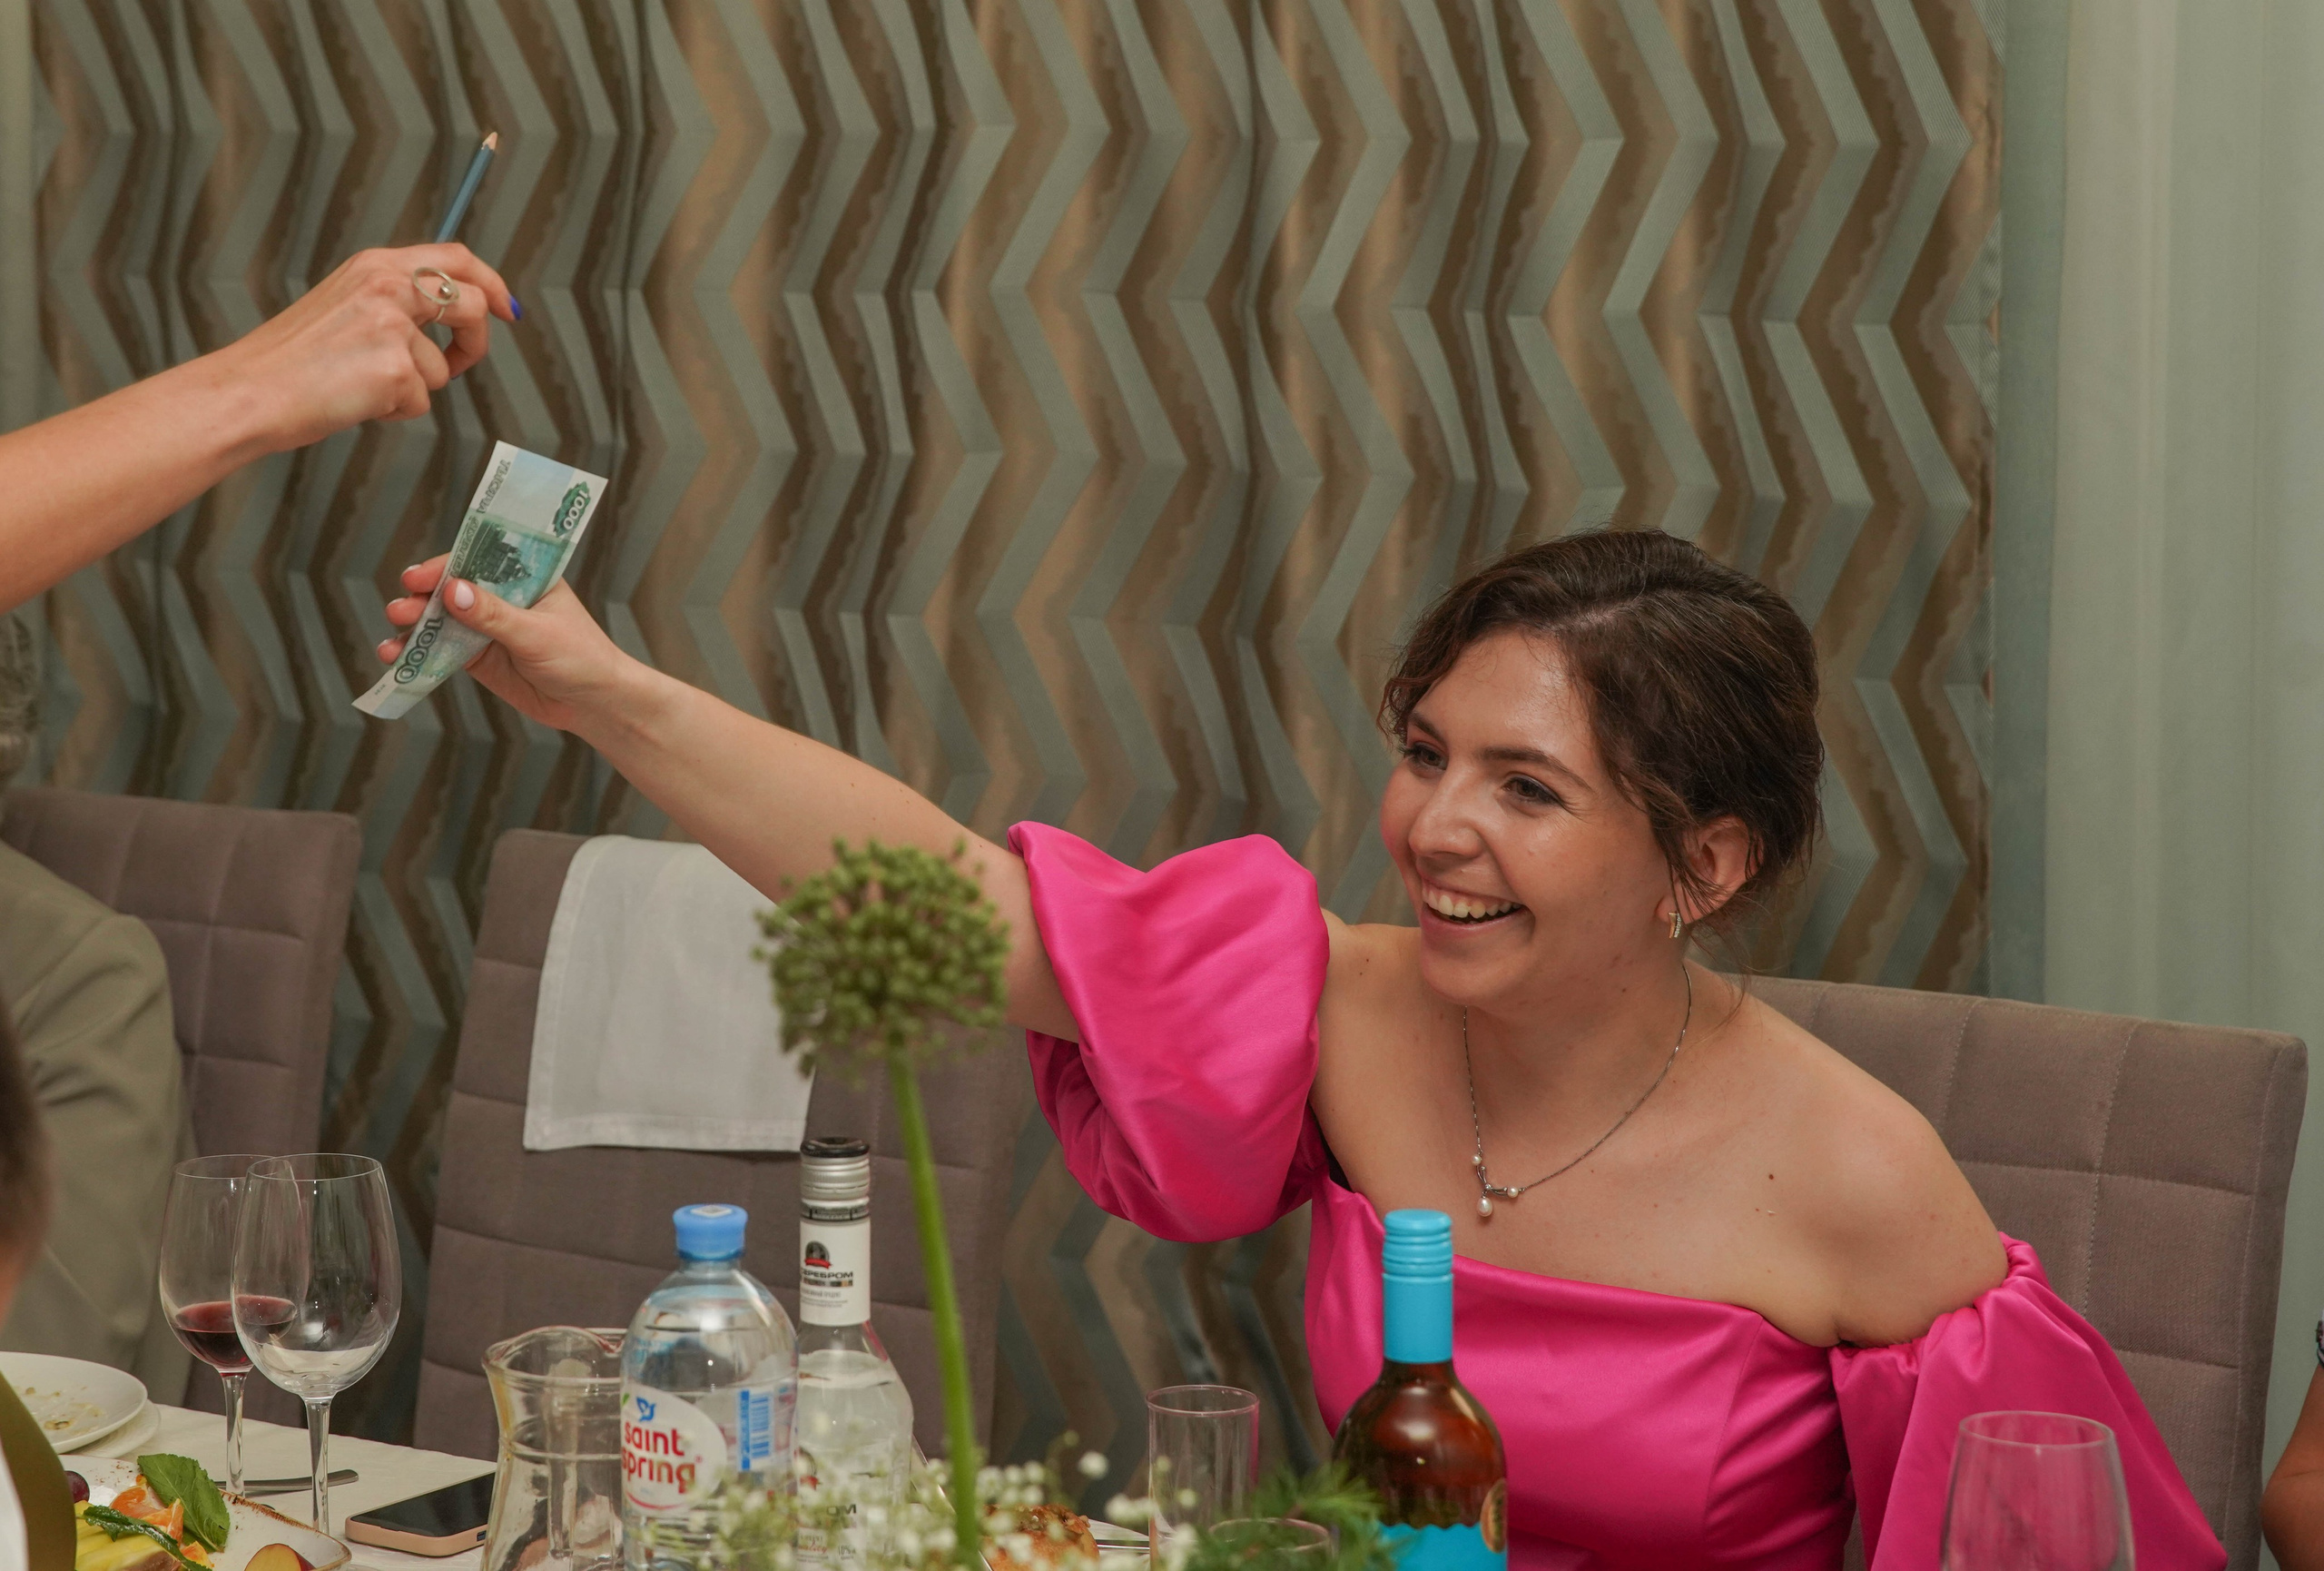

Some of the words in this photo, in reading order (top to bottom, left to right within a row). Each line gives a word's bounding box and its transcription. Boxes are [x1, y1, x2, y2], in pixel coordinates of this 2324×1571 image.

[562, 489, 590, 530] 1000
[394, 617, 445, 684] 1000
[625, 1421, 685, 1457] saint
[622, 1446, 695, 1494] spring
